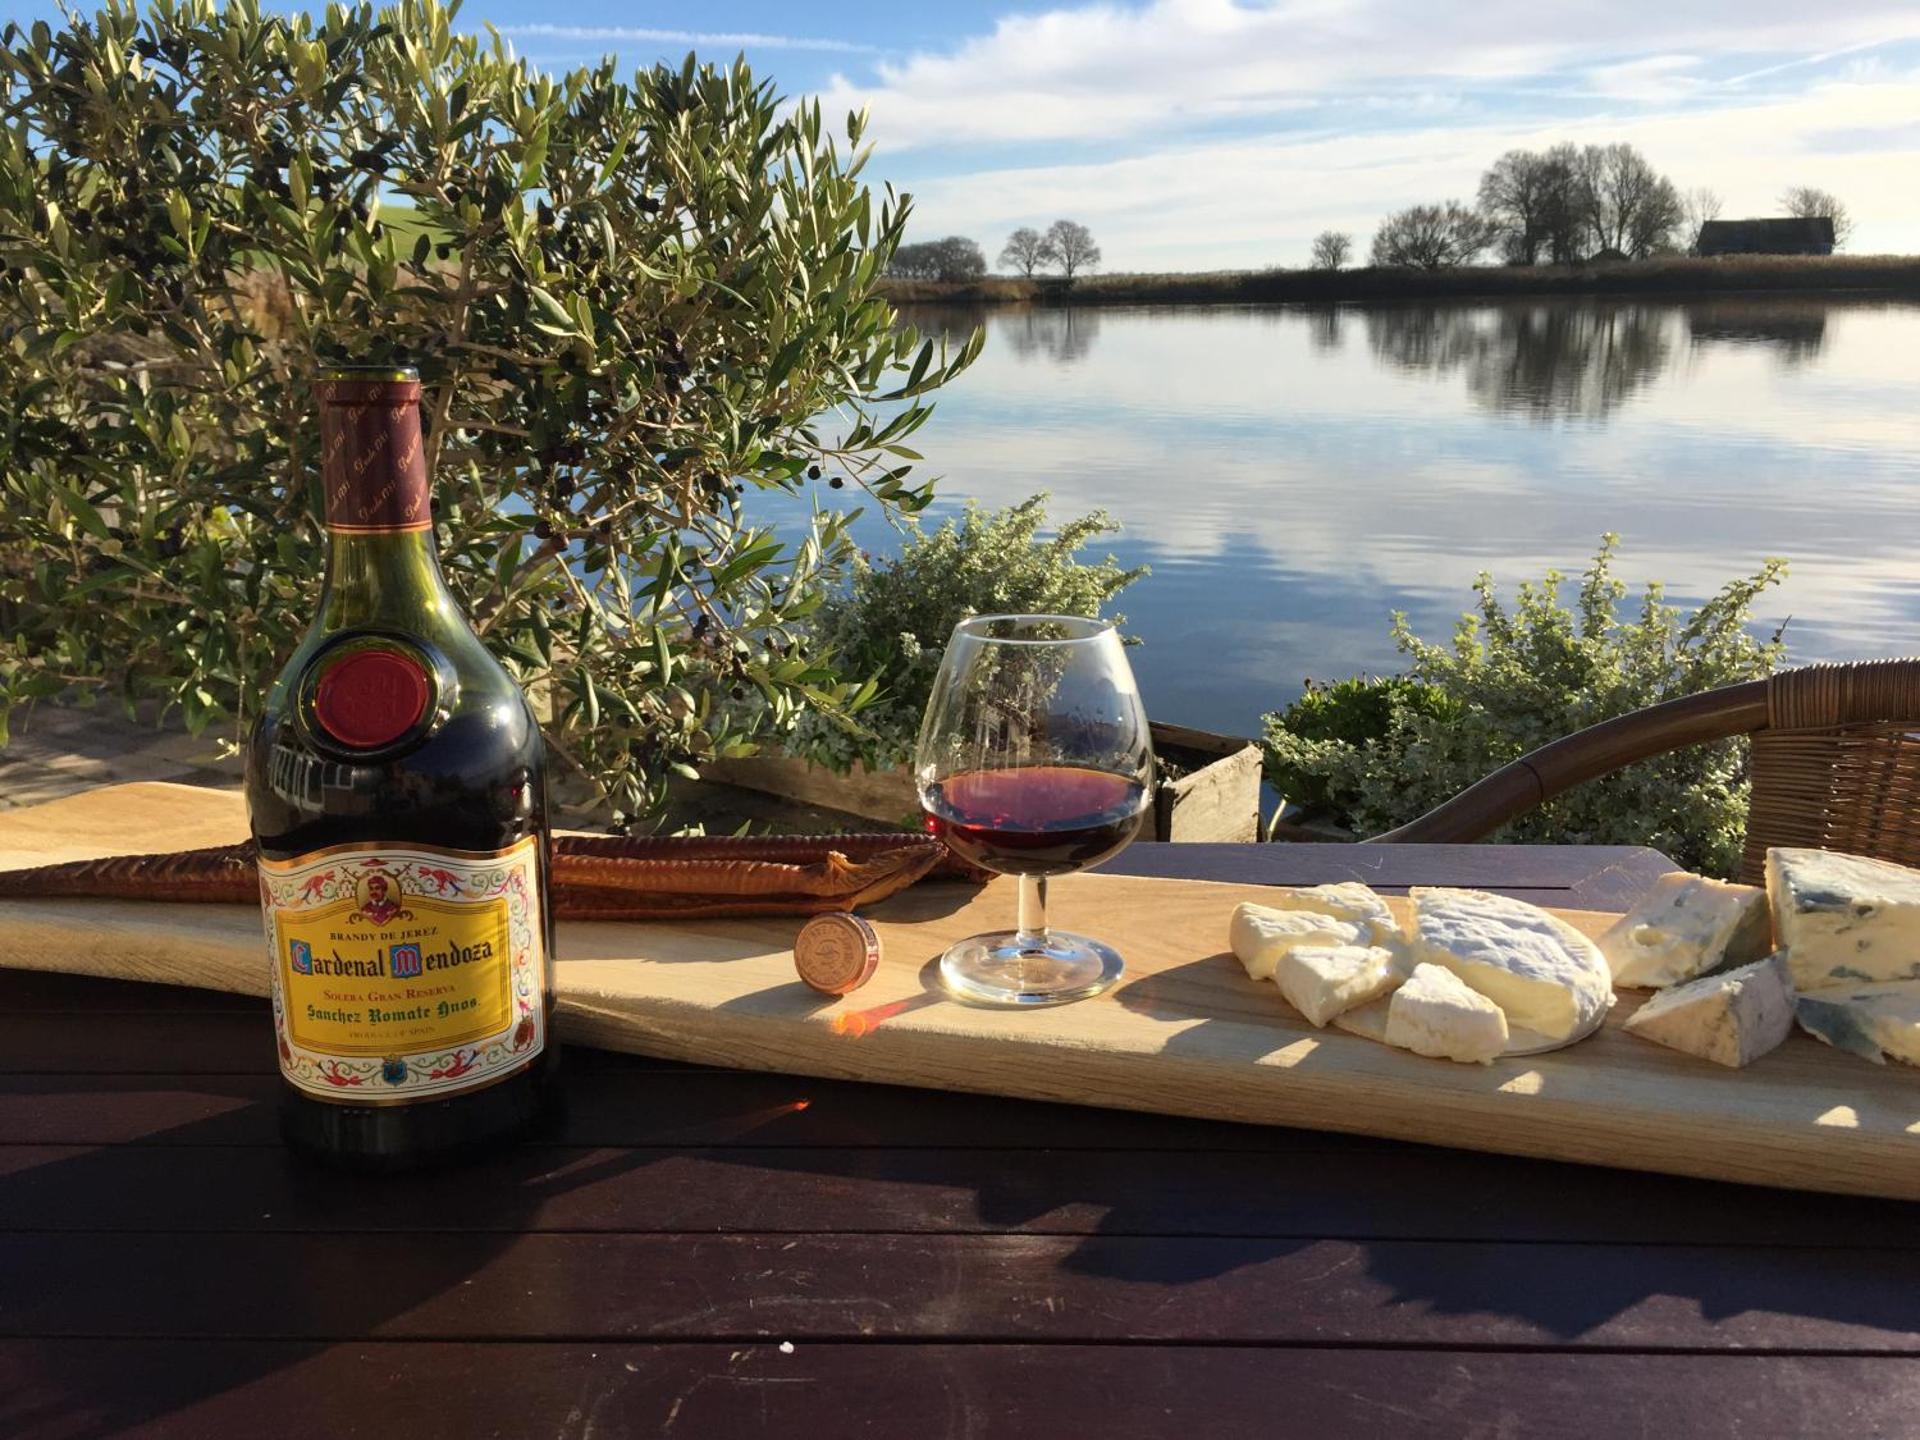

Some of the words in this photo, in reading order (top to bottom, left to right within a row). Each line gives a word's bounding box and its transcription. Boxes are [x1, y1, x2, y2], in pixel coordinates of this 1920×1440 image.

[329, 932, 377, 941] BRANDY
[380, 931, 396, 940] DE
[400, 926, 439, 939] JEREZ
[289, 938, 385, 976] Cardenal
[389, 939, 494, 979] Mendoza
[307, 1004, 362, 1025] Sanchez
[368, 1006, 431, 1026] Romate
